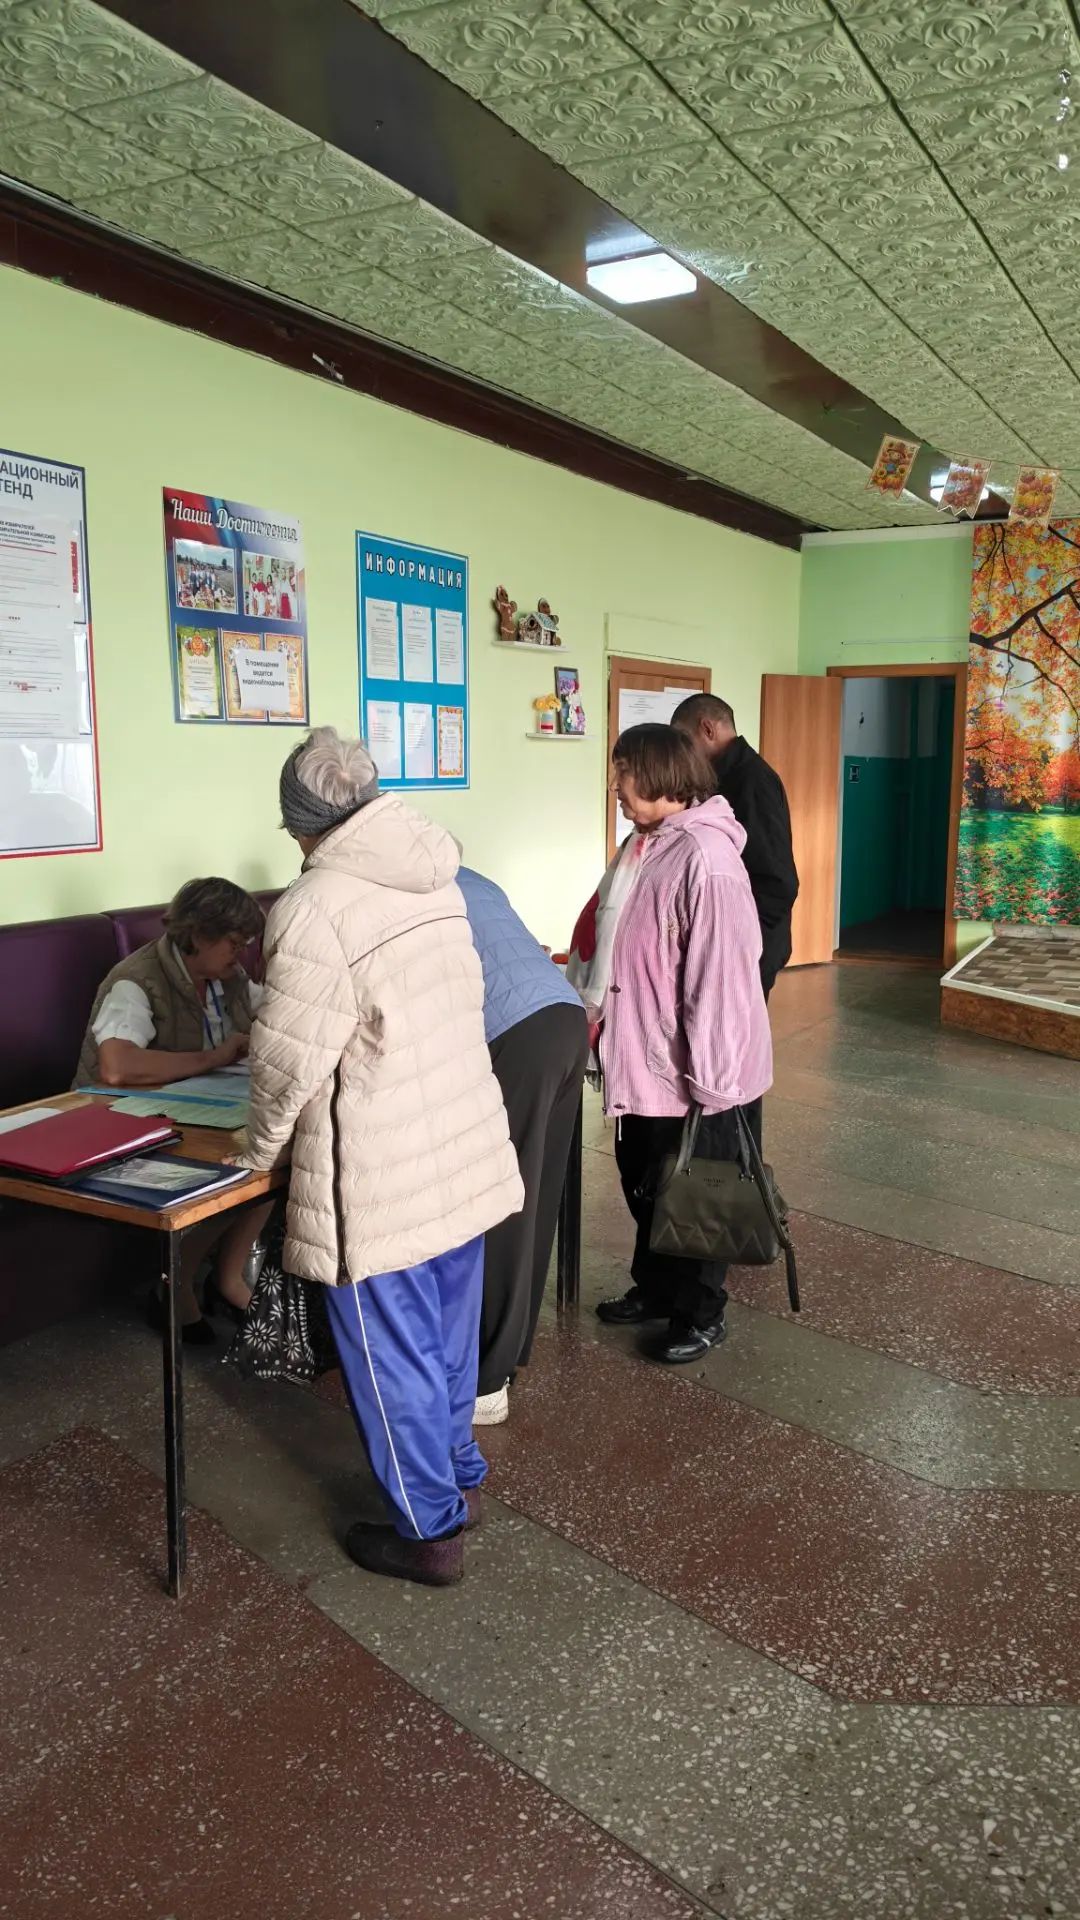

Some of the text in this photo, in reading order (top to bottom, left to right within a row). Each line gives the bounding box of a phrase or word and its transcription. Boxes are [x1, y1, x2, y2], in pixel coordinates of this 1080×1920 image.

[171, 497, 298, 541] Наши Достижения
[365, 551, 463, 589] ИНФОРМАЦИЯ
